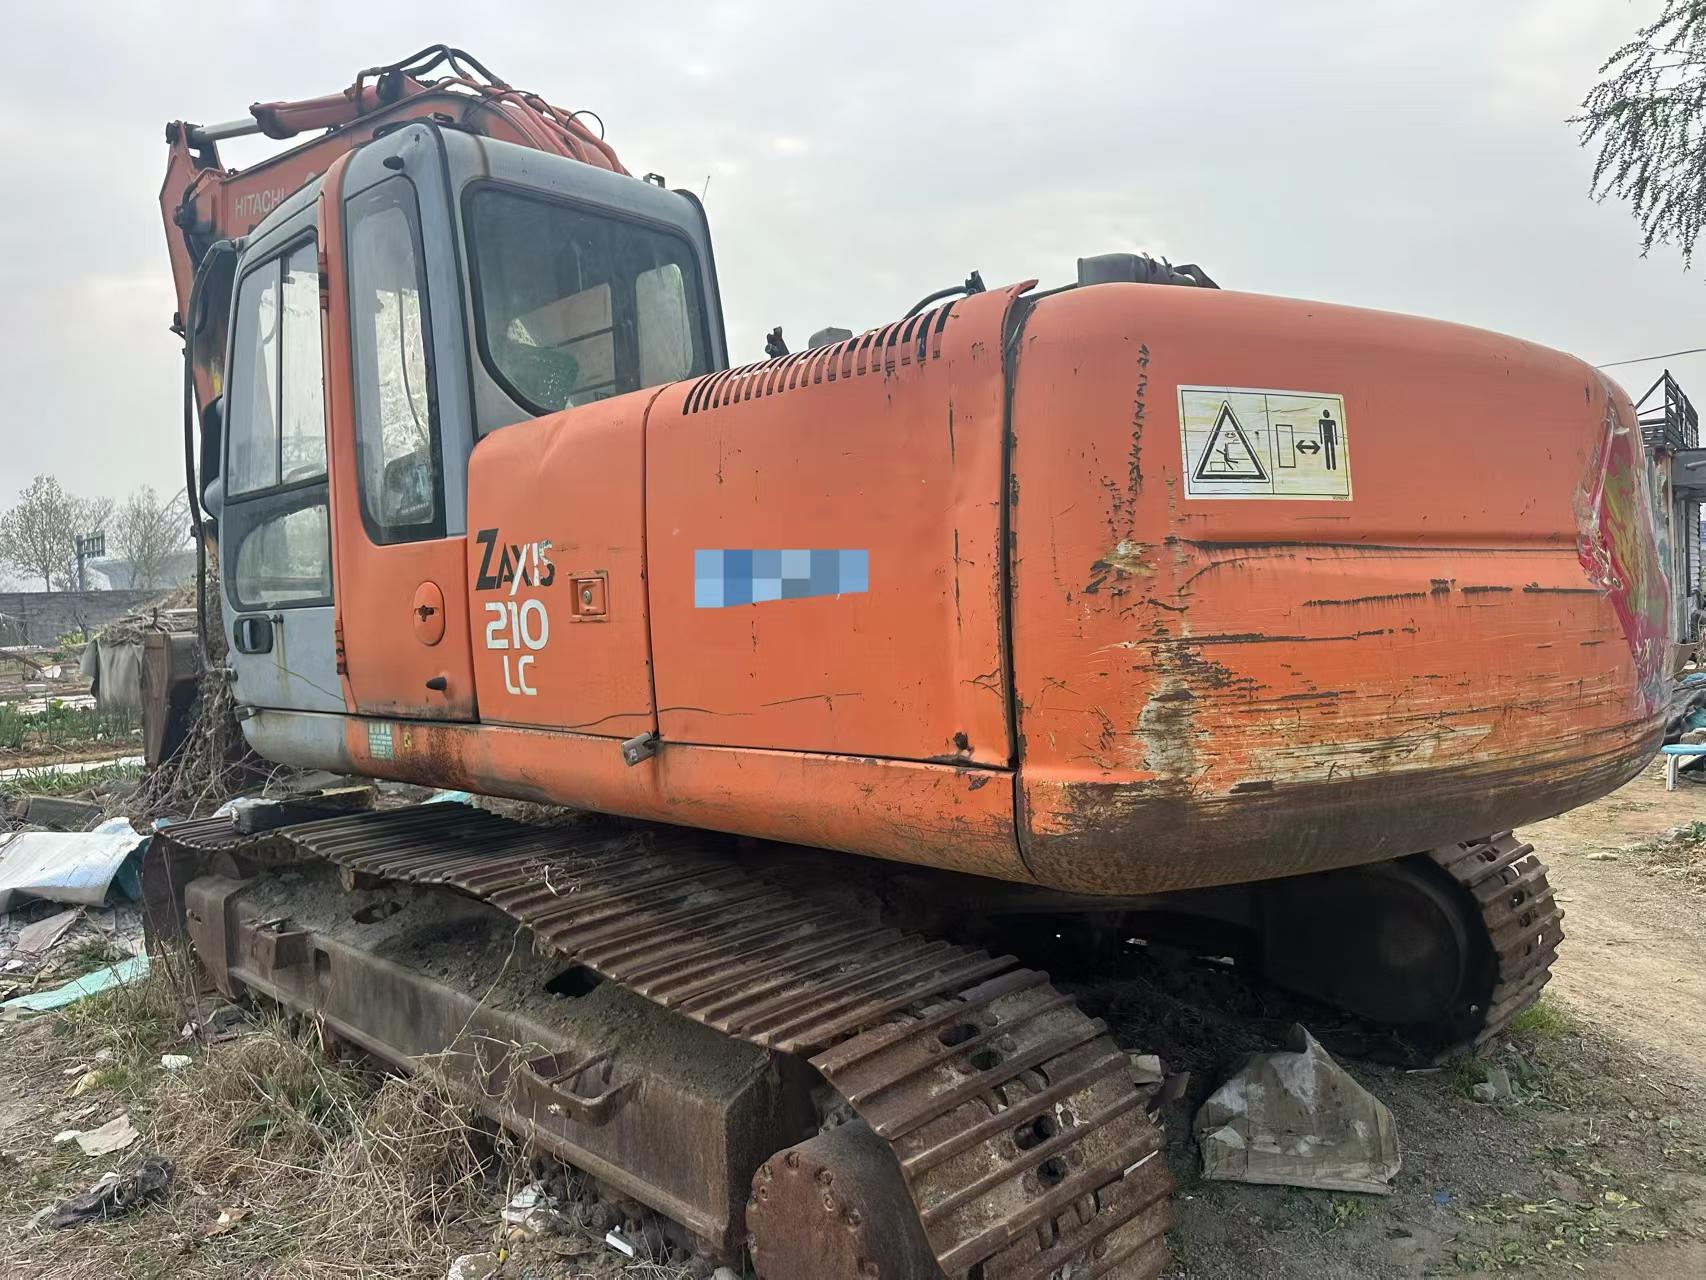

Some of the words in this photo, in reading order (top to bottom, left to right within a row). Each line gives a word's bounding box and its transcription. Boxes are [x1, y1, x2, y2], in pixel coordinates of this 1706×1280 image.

[476, 528, 555, 596] ZAXIS
[485, 599, 549, 650] 210
[503, 655, 537, 696] LC
